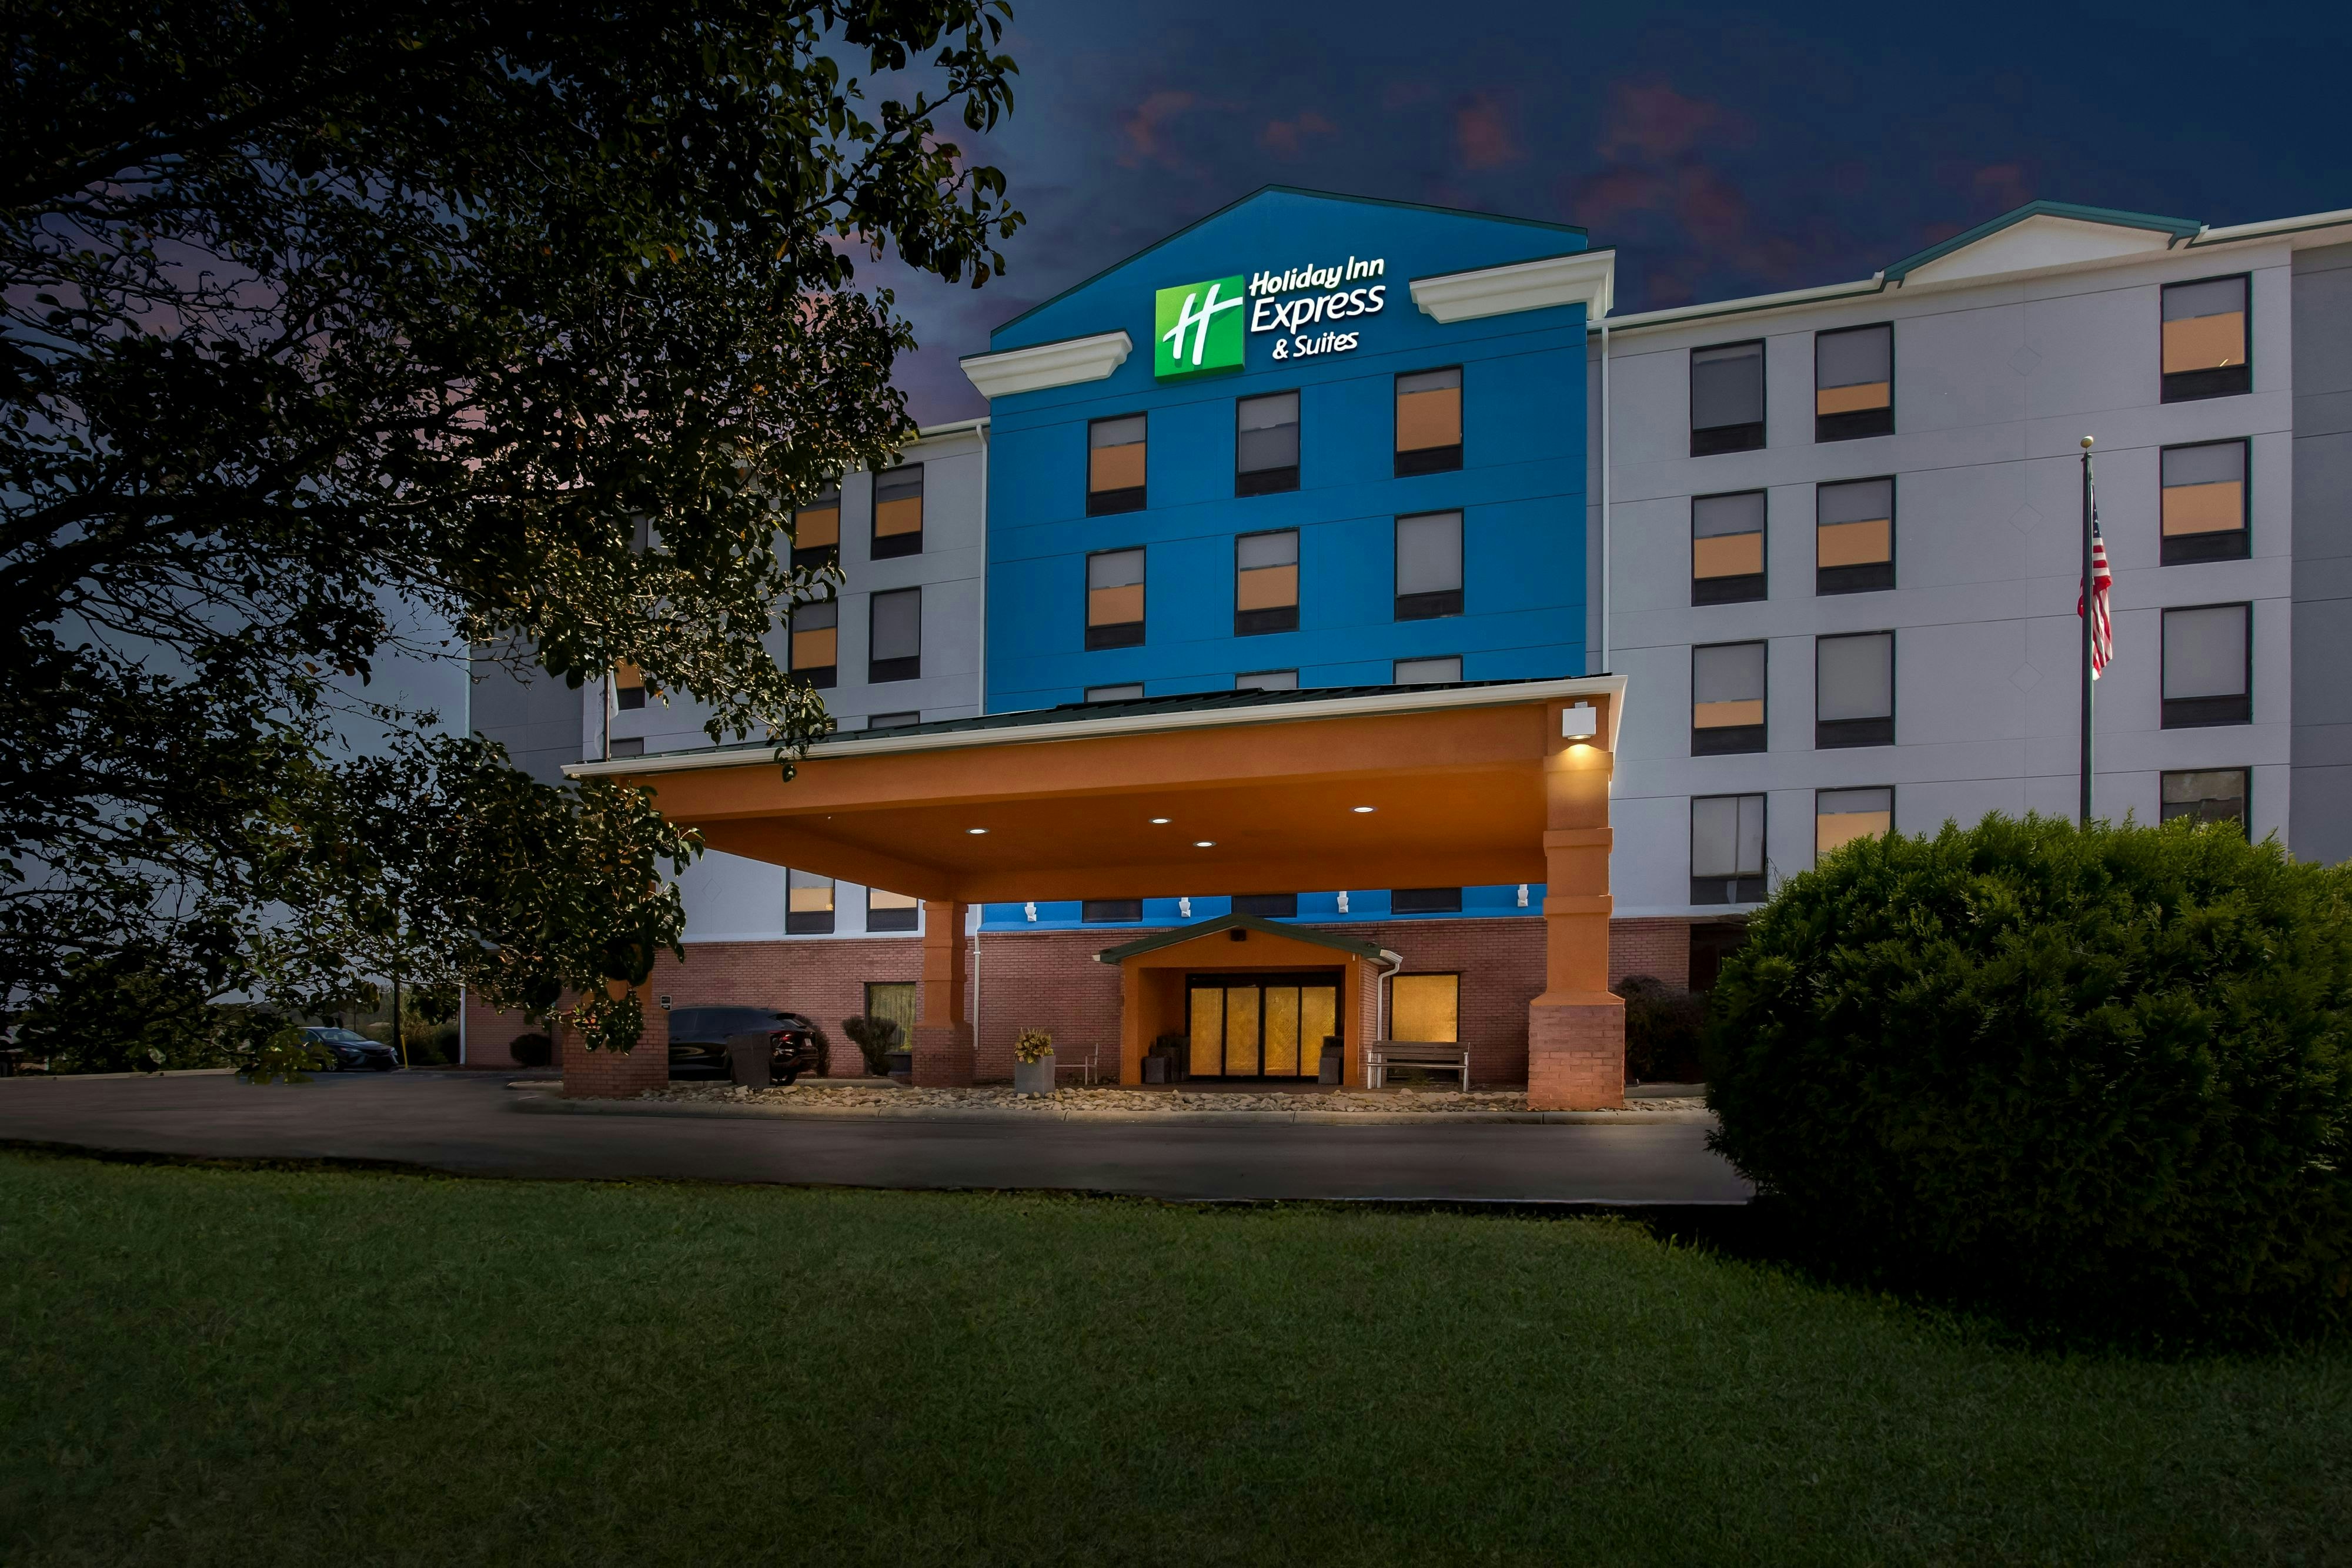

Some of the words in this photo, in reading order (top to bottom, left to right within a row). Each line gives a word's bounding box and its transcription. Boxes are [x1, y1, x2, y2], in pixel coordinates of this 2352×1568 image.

[1248, 263, 1343, 296] Holiday
[1345, 256, 1384, 281] Inn
[1251, 285, 1386, 335] Express
[1272, 339, 1289, 360] &
[1292, 332, 1359, 357] Suites
